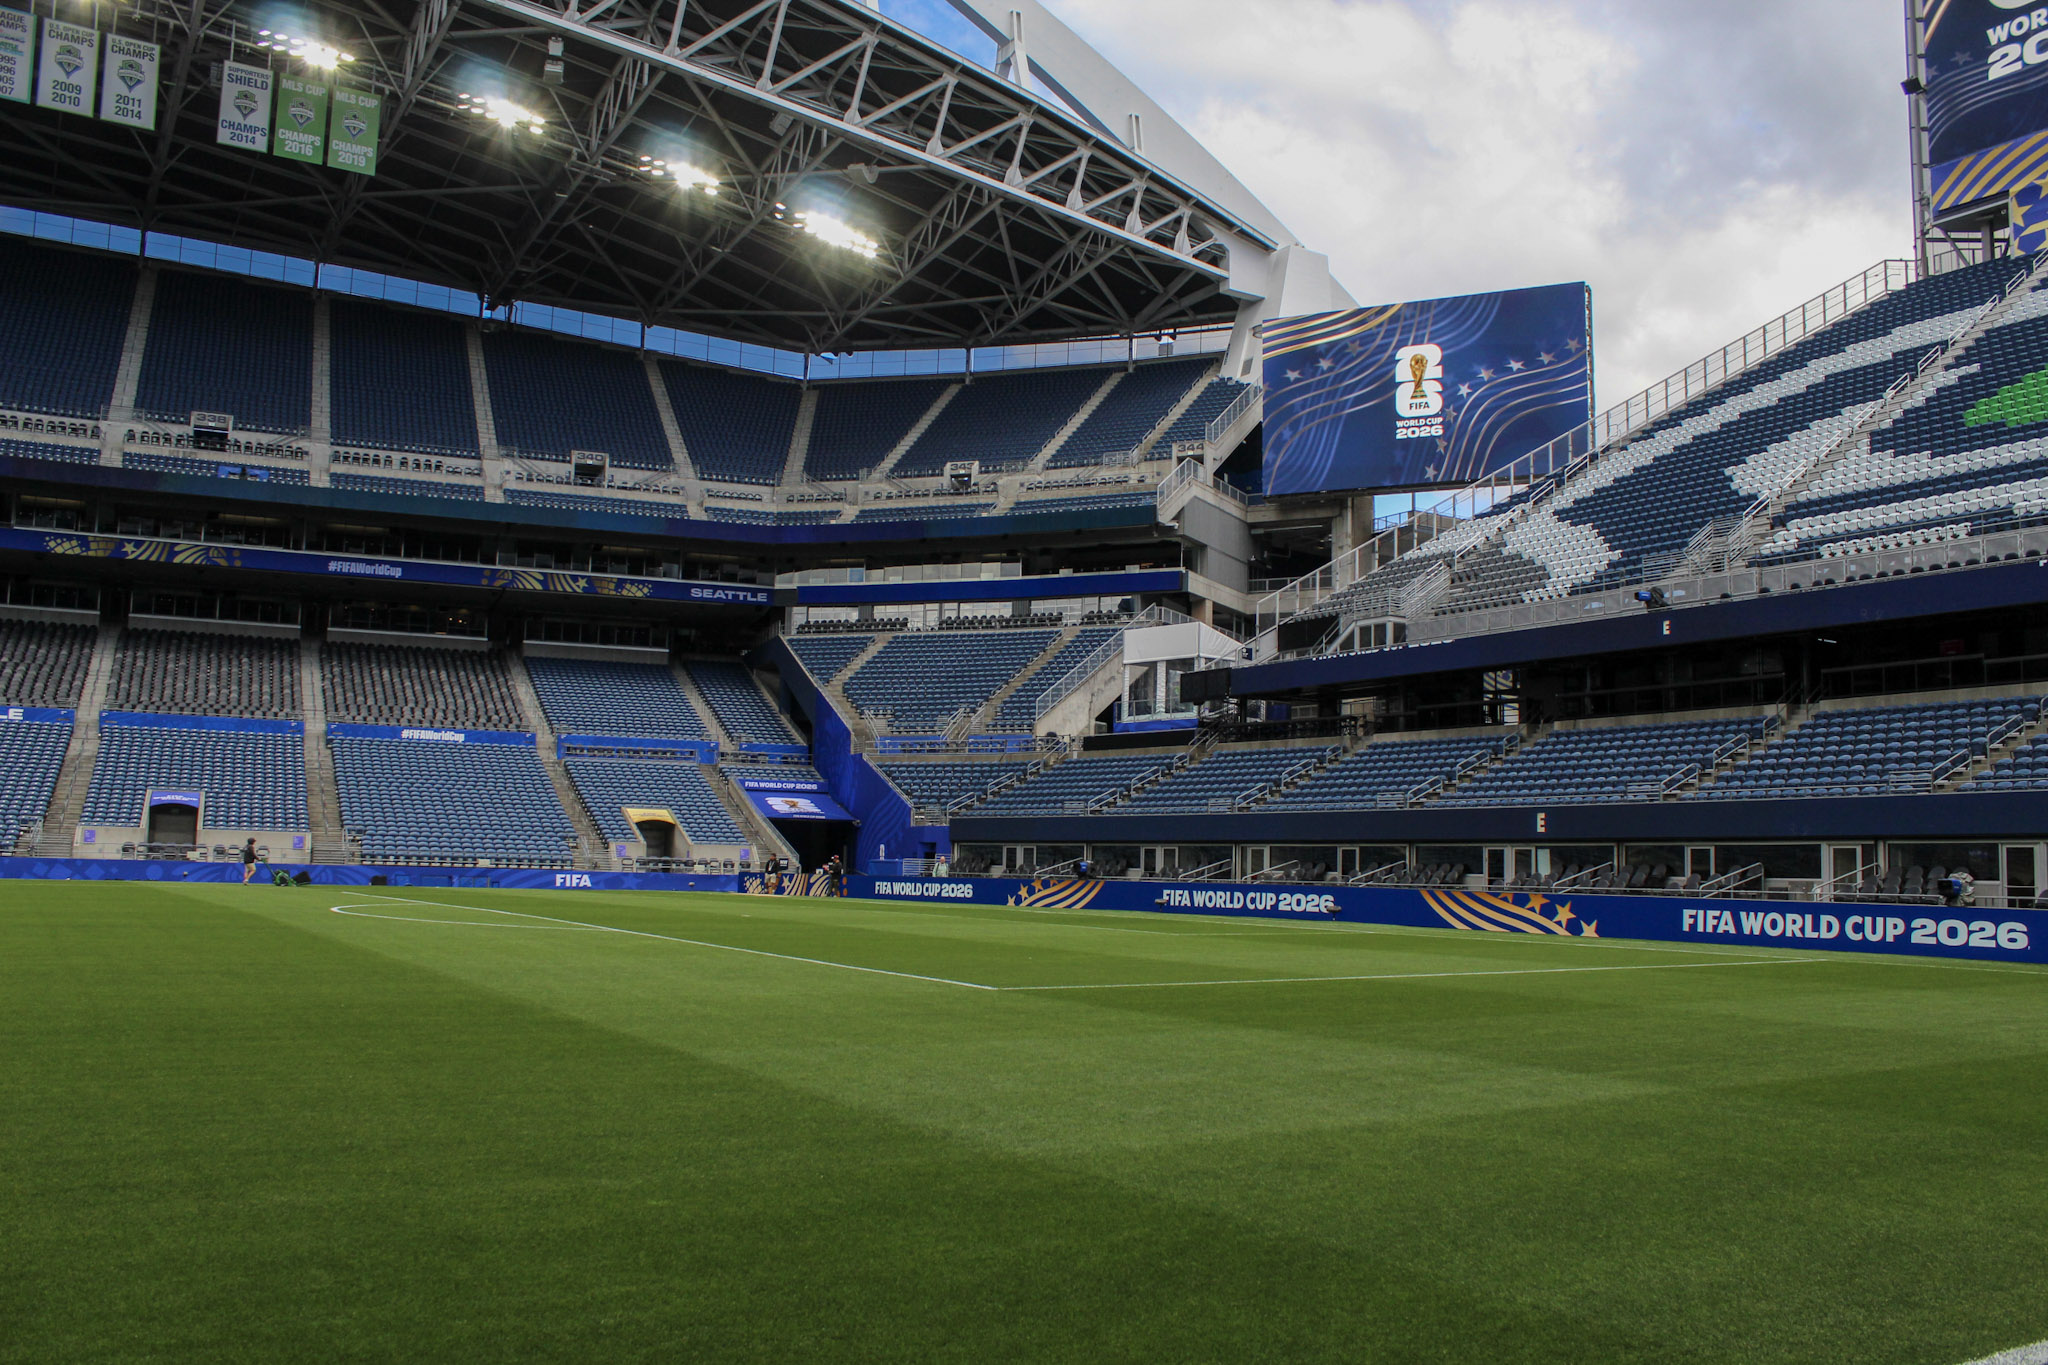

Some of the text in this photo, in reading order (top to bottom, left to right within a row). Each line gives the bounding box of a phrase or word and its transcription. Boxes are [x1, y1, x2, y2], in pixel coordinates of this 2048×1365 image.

[48, 29, 95, 48] CHAMPS
[111, 44, 155, 62] CHAMPS
[52, 79, 82, 95] 2009
[227, 72, 268, 91] SHIELD
[282, 78, 326, 96] MLS CUP
[51, 91, 81, 107] 2010
[116, 93, 142, 109] 2011
[335, 91, 378, 108] MLS CUP
[114, 105, 142, 120] 2014
[221, 119, 267, 137] CHAMPS
[229, 131, 256, 145] 2014
[278, 128, 321, 146] CHAMPS
[284, 140, 313, 156] 2016
[332, 139, 374, 157] CHAMPS
[338, 151, 366, 167] 2019
[1409, 401, 1430, 410] FIFA
[1396, 417, 1443, 428] WORLD CUP
[1396, 424, 1444, 440] 2026
[1178, 443, 1204, 452] 344
[577, 452, 604, 461] 340
[328, 560, 402, 578] #FIFAWorldCup
[690, 588, 768, 602] SEATTLE
[1663, 620, 1671, 635] E
[401, 729, 465, 743] #FIFAWorldCup
[1536, 812, 1547, 833] E
[555, 874, 592, 887] FIFA
[875, 881, 973, 898] FIFA WORLD CUP 2026
[1162, 889, 1336, 914] FIFA WORLD CUP 2026
[1682, 908, 2029, 950] FIFA WORLD CUP 2026
